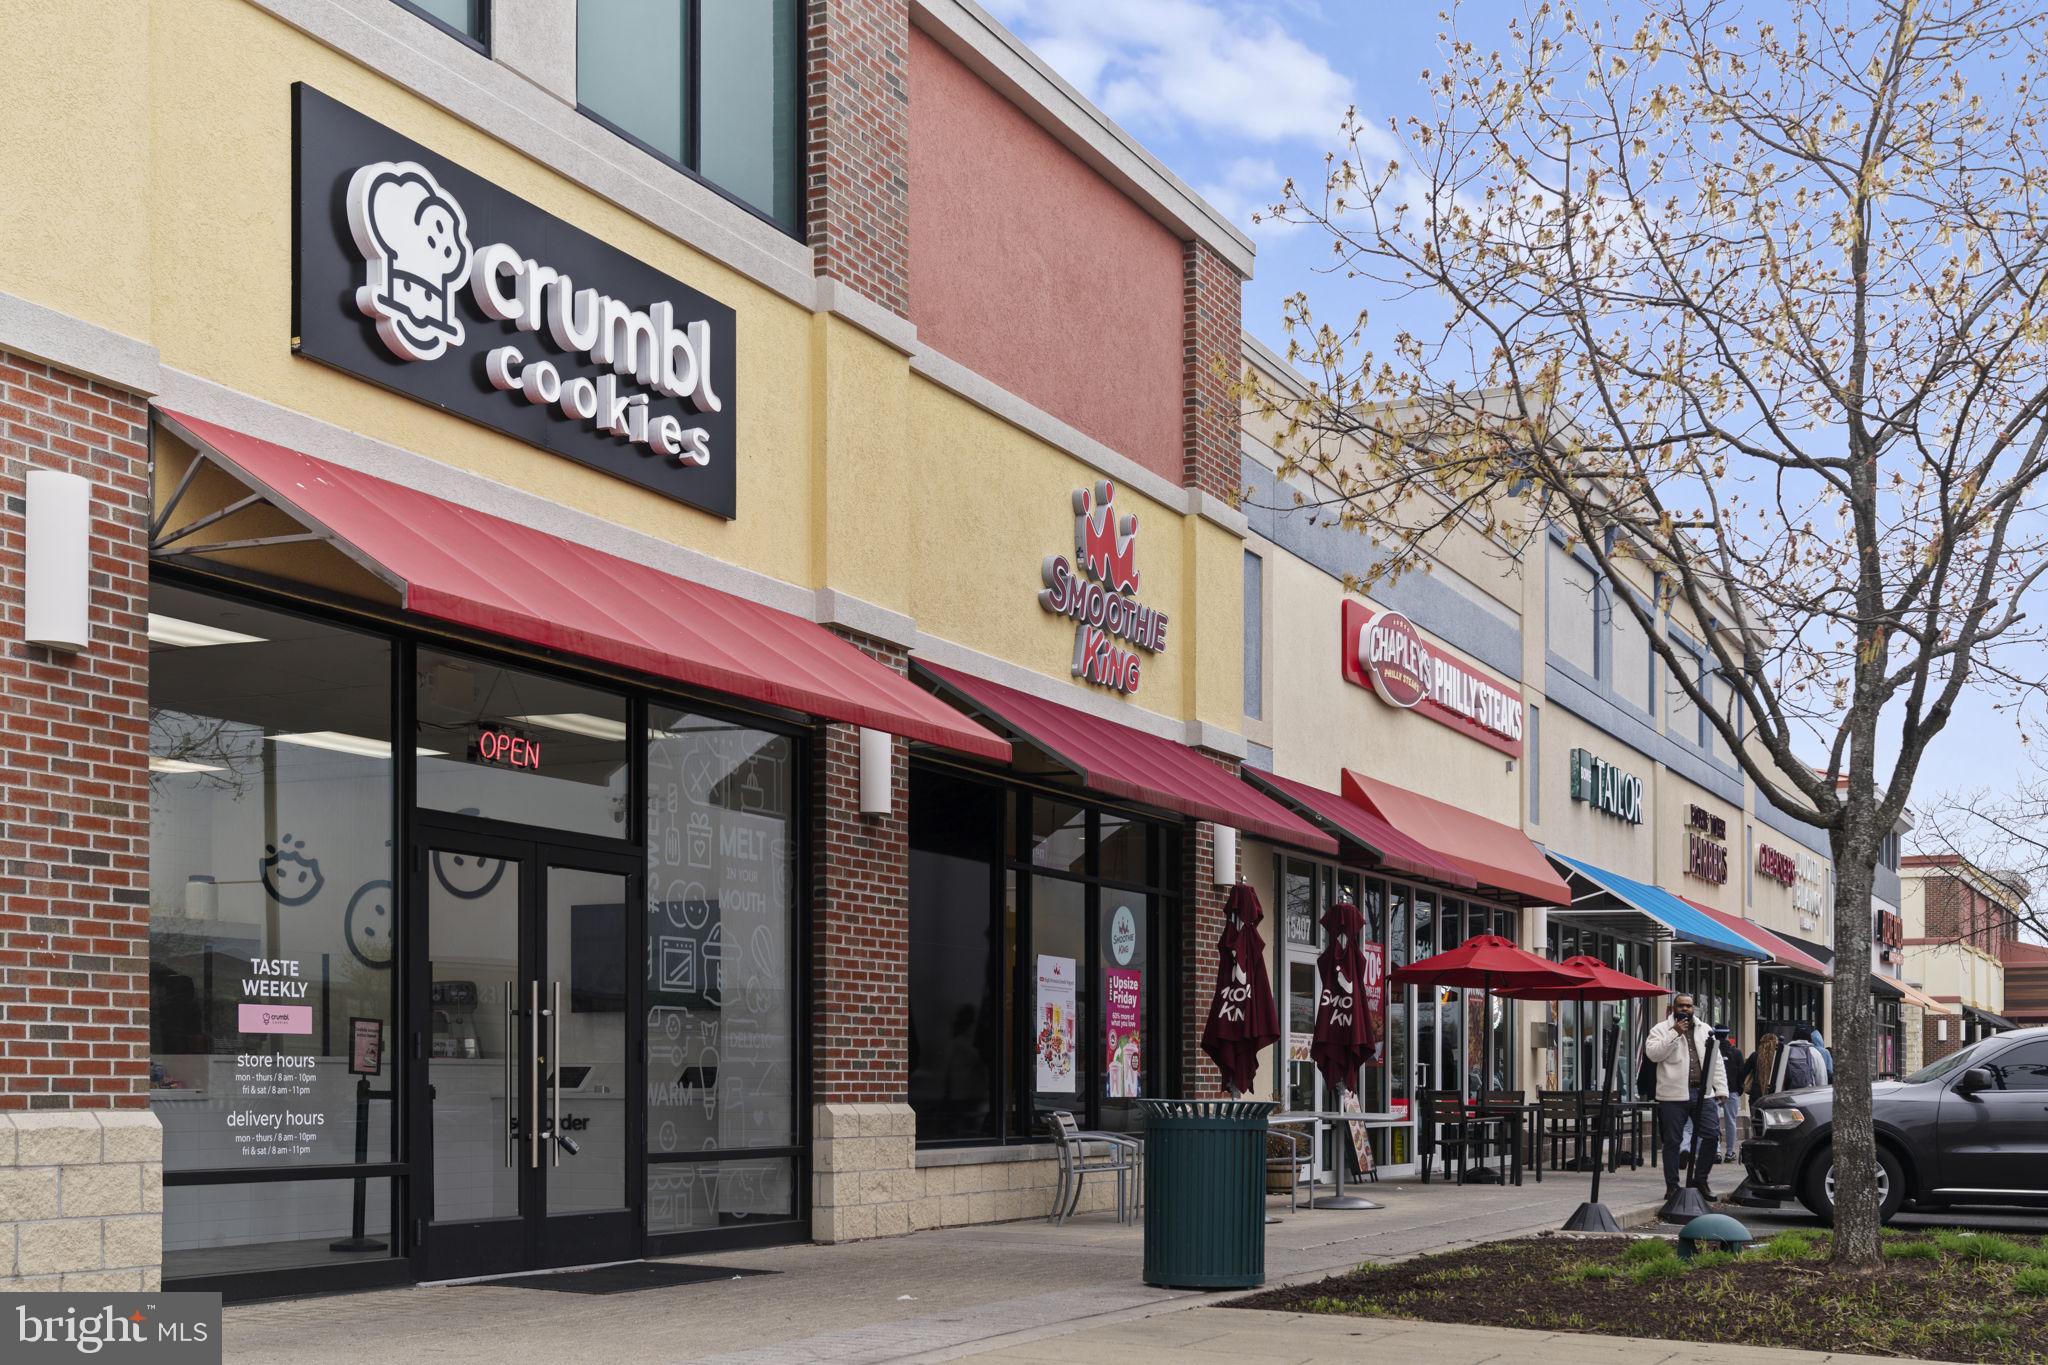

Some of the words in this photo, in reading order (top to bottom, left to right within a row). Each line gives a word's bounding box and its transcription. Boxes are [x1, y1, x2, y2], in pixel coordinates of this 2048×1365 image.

[470, 242, 722, 413] crumbl
[1038, 555, 1169, 653] SMOOTHIE
[1435, 657, 1478, 719] PHILLY
[1479, 682, 1523, 742] STEAKS
[480, 731, 541, 769] OPEN
[1595, 757, 1643, 825] TAILOR
[719, 824, 768, 862] MELT
[1689, 832, 1728, 885] BARBERS
[1759, 842, 1796, 888] CLEANERS
[726, 867, 736, 880] IN
[738, 870, 759, 883] YOUR
[719, 888, 767, 913] MOUTH
[1286, 915, 1311, 941] 15407
[250, 958, 300, 977] TASTE
[242, 979, 309, 998] WEEKLY
[1113, 975, 1138, 992] Upsize
[1113, 991, 1137, 1008] Friday
[271, 1013, 290, 1021] crumbl
[237, 1053, 273, 1068] store
[276, 1052, 316, 1068] hours
[256, 1073, 273, 1082] thurs
[278, 1073, 282, 1082] 8
[299, 1073, 316, 1082] 10pm
[250, 1086, 256, 1094] &
[256, 1086, 266, 1094] sat
[272, 1086, 276, 1094] 8
[648, 1082, 693, 1106] WARM
[226, 1110, 282, 1130] delivery
[286, 1110, 324, 1126] hours
[256, 1133, 273, 1141] thurs
[278, 1133, 282, 1141] 8
[299, 1133, 316, 1142] 10pm
[250, 1146, 256, 1155] &
[256, 1147, 266, 1155] sat
[272, 1146, 276, 1154] 8
